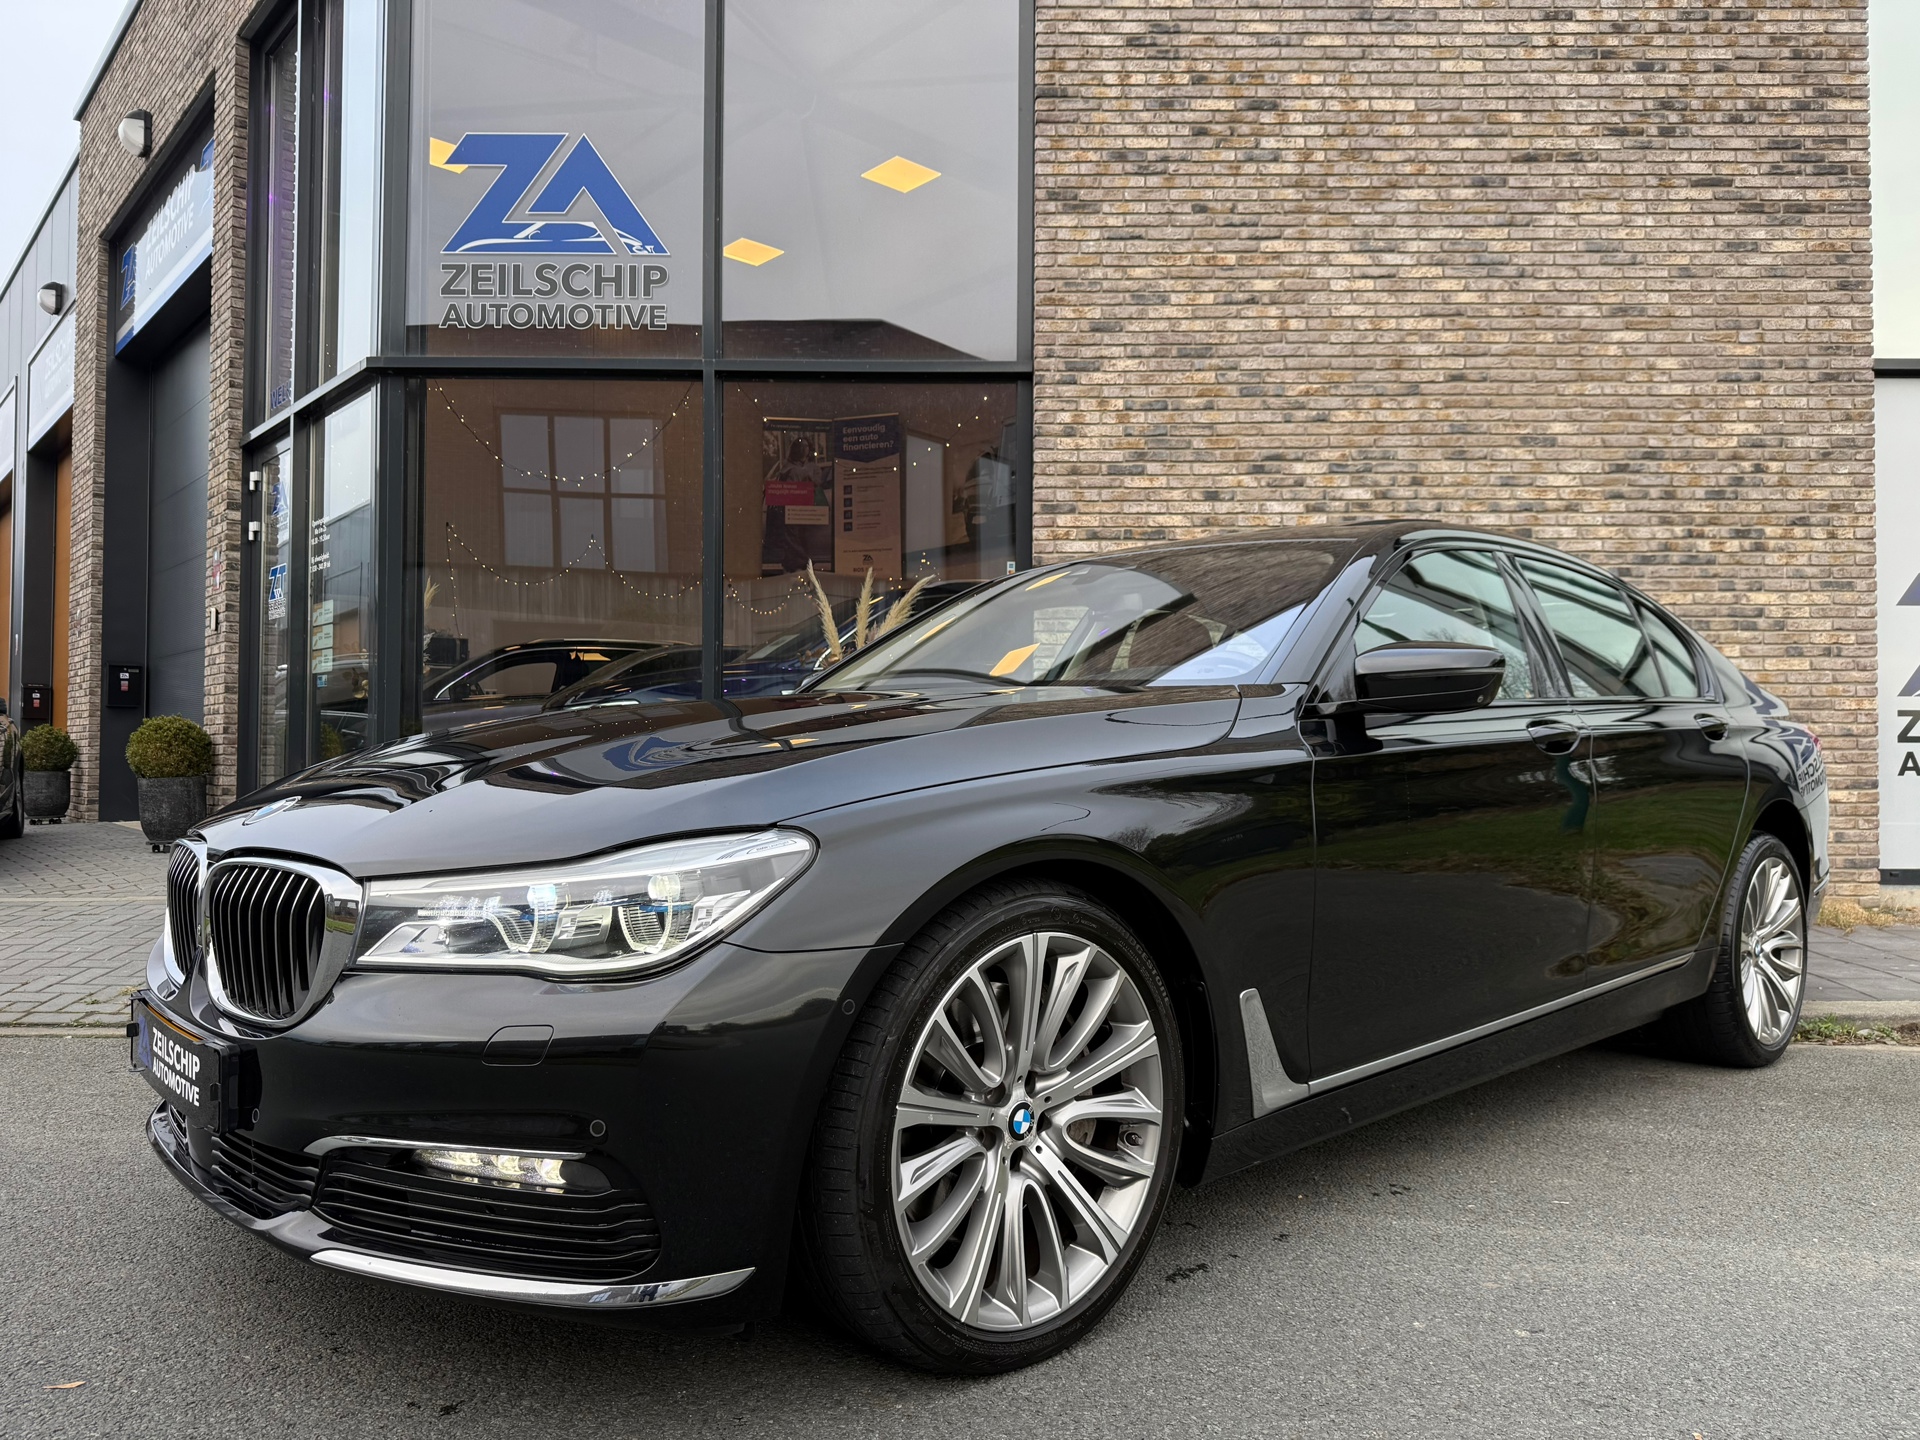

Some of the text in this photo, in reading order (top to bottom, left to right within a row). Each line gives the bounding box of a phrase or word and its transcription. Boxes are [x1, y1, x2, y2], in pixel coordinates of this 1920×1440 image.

[145, 163, 196, 253] ZEILSCHIP
[440, 132, 671, 256] ZA
[144, 201, 195, 281] AUTOMOTIVE
[439, 262, 669, 299] ZEILSCHIP
[438, 302, 668, 330] AUTOMOTIVE
[842, 423, 886, 434] Eenvoudig
[842, 434, 859, 443] een
[842, 440, 895, 452] financieren?
[152, 1026, 201, 1081] ZEILSCHIP
[152, 1056, 200, 1107] AUTOMOTIVE
